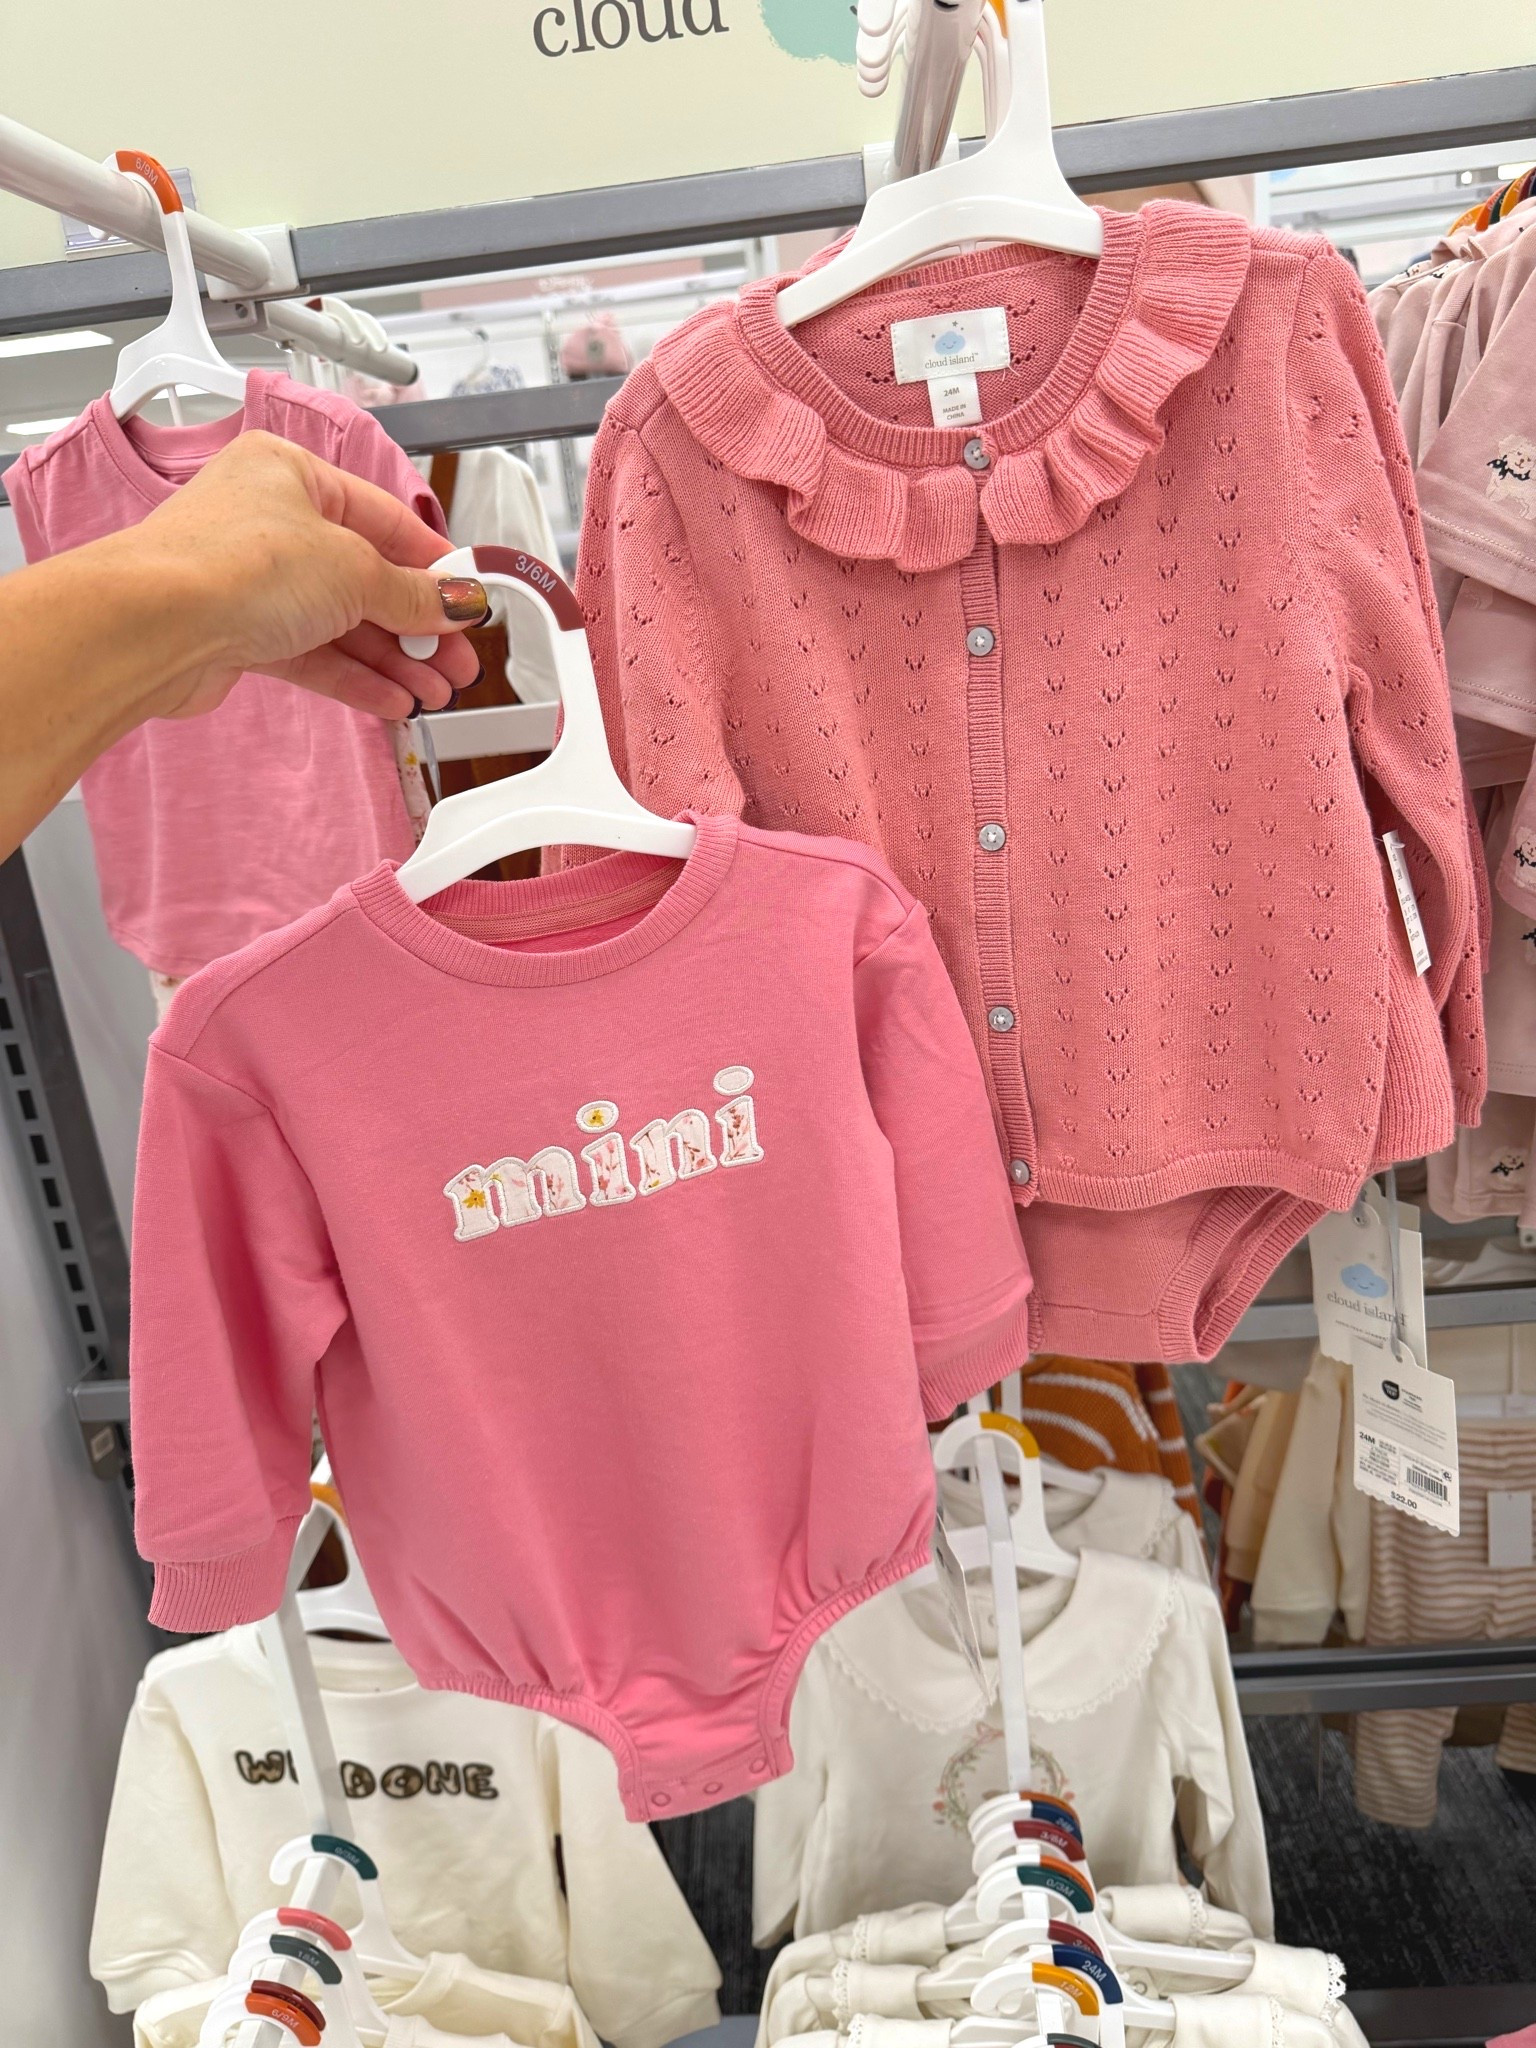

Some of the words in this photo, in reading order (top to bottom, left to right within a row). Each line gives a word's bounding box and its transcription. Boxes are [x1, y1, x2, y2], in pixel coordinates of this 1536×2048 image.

[135, 158, 159, 185] 6/9M
[924, 356, 948, 369] cloud
[943, 387, 960, 397] 24M
[942, 405, 960, 414] MADE
[946, 412, 965, 420] CHINA
[515, 555, 557, 593] 3/6M
[443, 1065, 764, 1242] mini
[1327, 1291, 1361, 1312] cloud
[1359, 1431, 1376, 1445] 24M
[1391, 1490, 1417, 1509] $22.00
[1046, 1878, 1075, 1897] 0/3M
[1081, 1960, 1107, 1982] 24M
[1060, 1981, 1083, 1998] 12M
[271, 2008, 299, 2028] 6/9M
